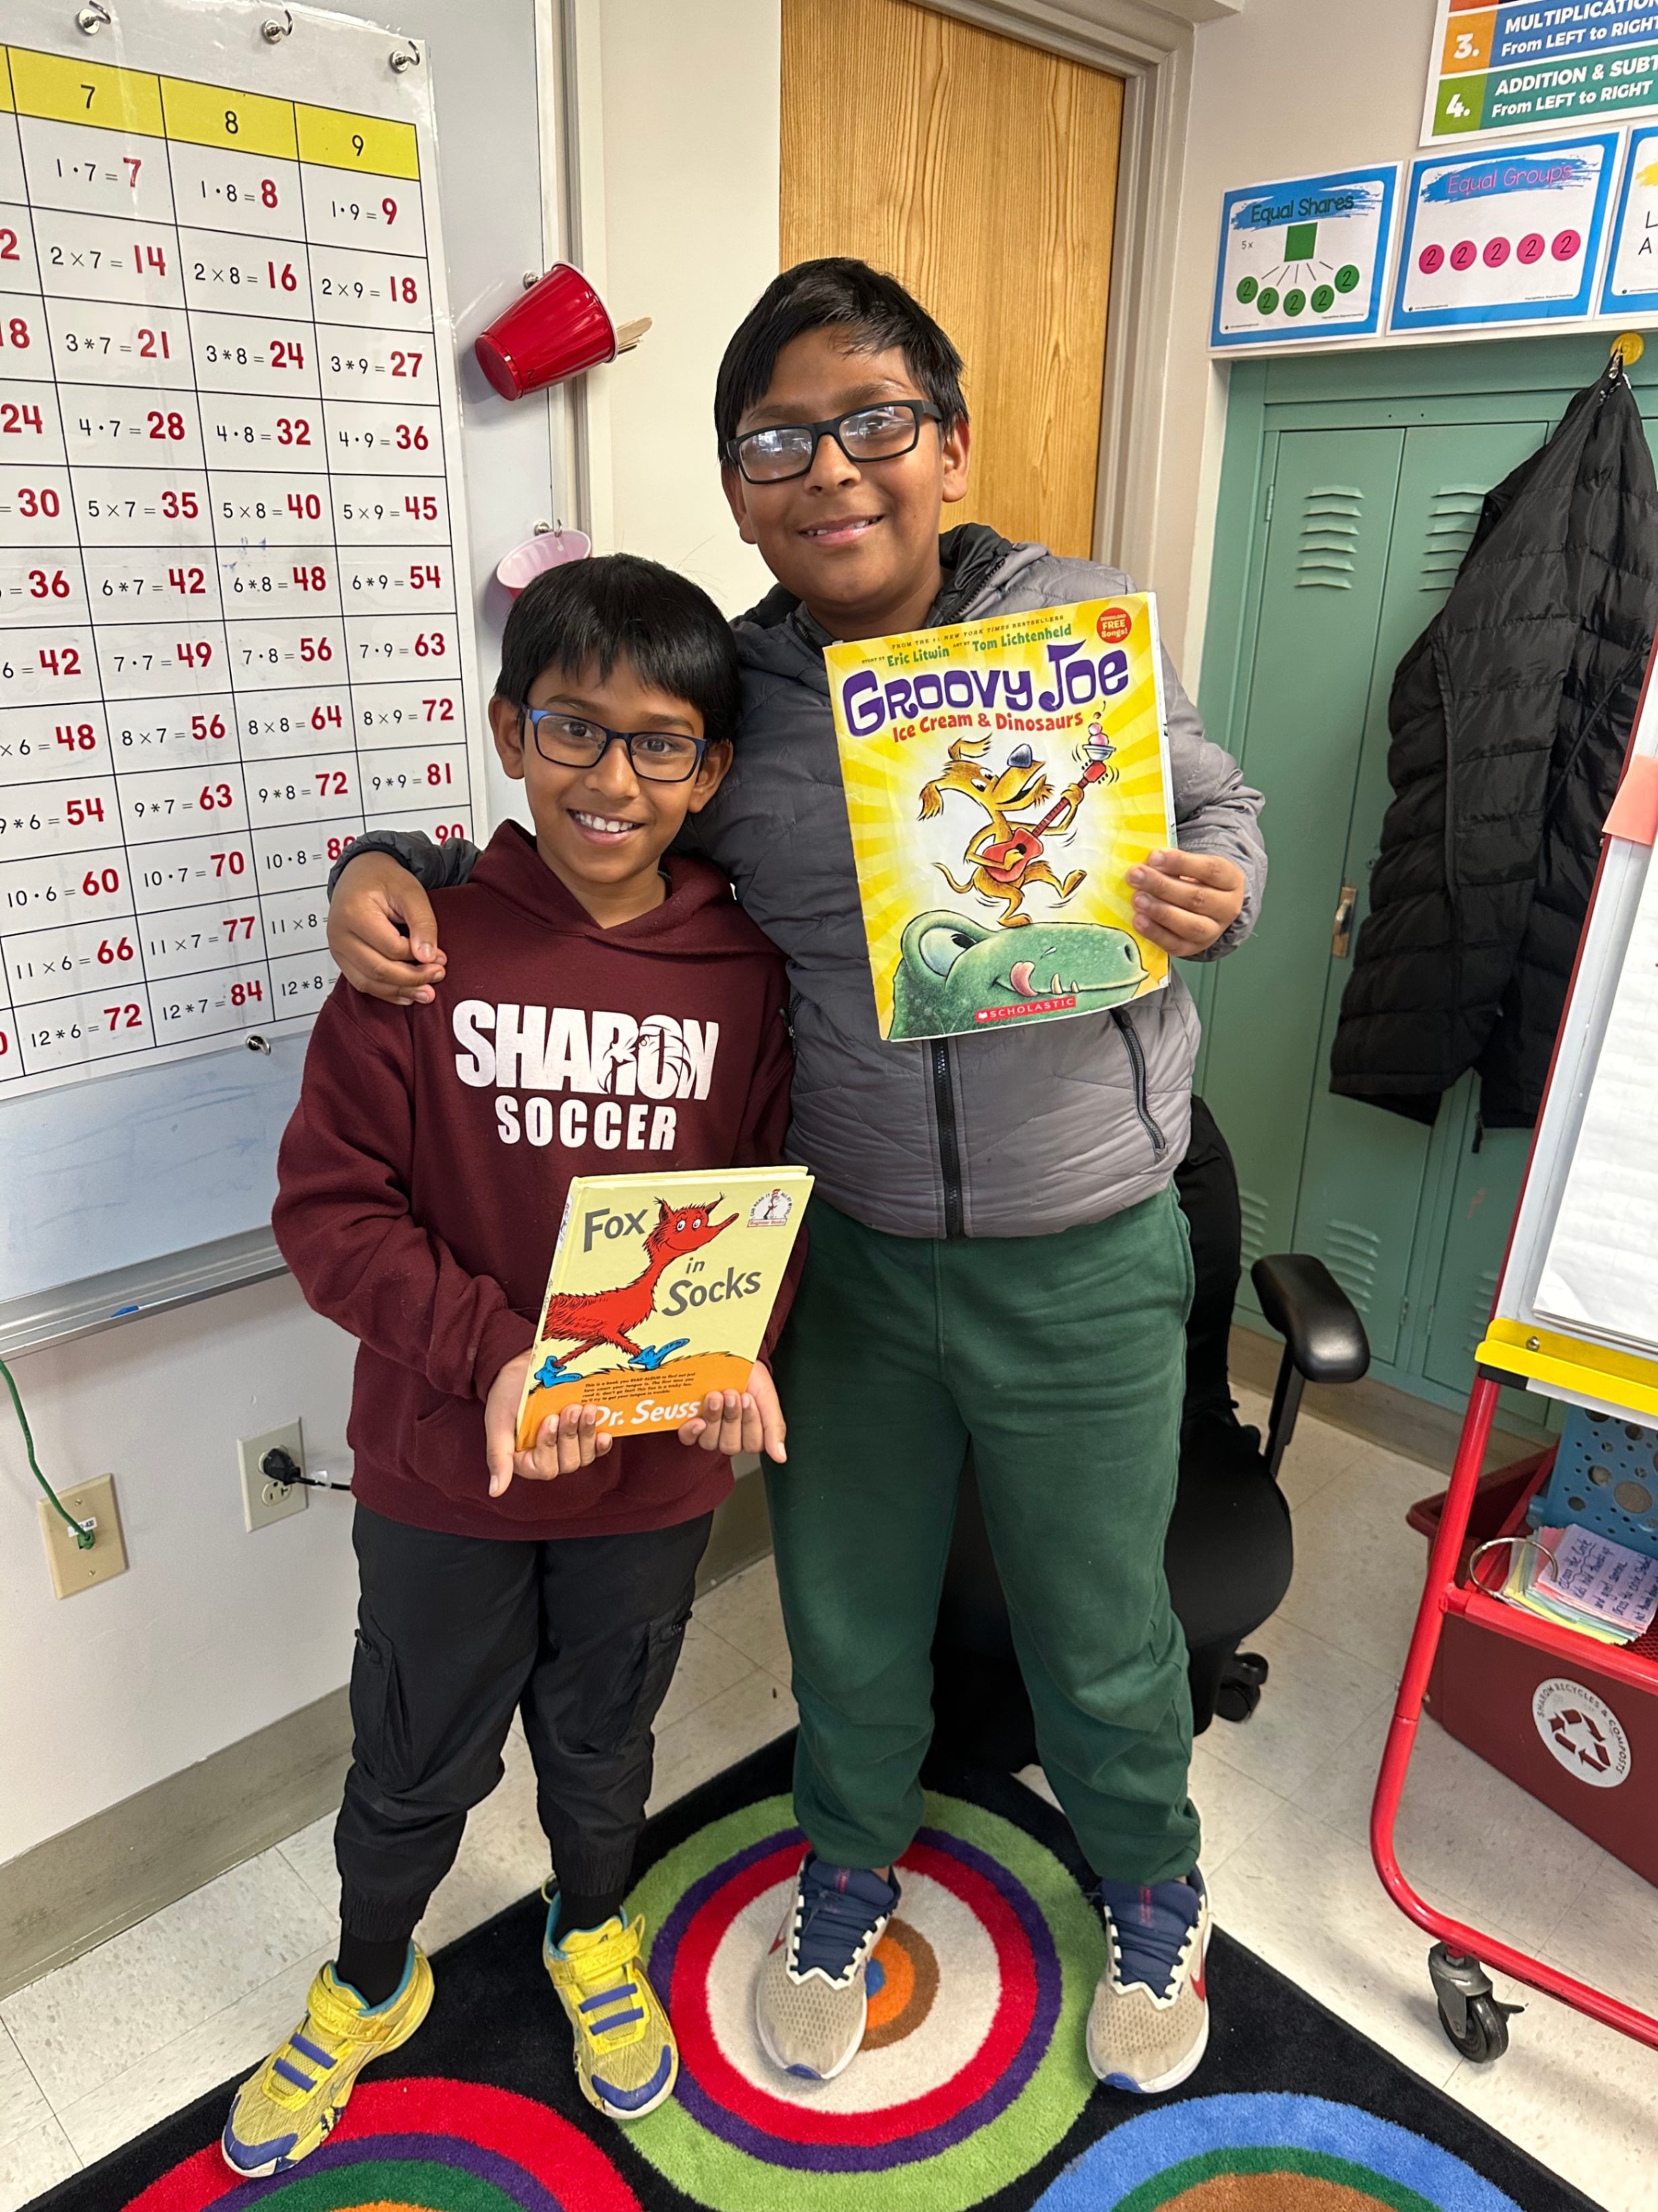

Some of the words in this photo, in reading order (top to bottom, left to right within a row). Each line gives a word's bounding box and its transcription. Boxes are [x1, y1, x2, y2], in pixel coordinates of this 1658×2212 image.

[1454, 34, 1479, 59] 3.
[1502, 38, 1541, 57] From
[1546, 29, 1587, 49] LEFT
[1590, 26, 1607, 40] to
[1495, 66, 1587, 96] ADDITION
[1592, 64, 1604, 80] &
[80, 84, 95, 109] 7
[1446, 94, 1471, 118] 4.
[1492, 102, 1531, 118] From
[1536, 92, 1576, 111] LEFT
[1579, 90, 1597, 104] to
[1600, 80, 1654, 102] RIGHT
[225, 110, 238, 134] 8
[352, 135, 364, 156] 9
[1448, 170, 1497, 197] Equal
[1503, 164, 1572, 187] Groups
[1250, 199, 1294, 226] Equal
[1298, 195, 1354, 216] Shares
[134, 245, 166, 276] 14
[1426, 249, 1436, 266] 2
[1457, 246, 1467, 264] 2
[1490, 243, 1502, 261] 2
[1525, 239, 1537, 257] 2
[1560, 236, 1572, 253] 2
[268, 261, 297, 292] 16
[390, 276, 418, 304] 18
[1242, 281, 1251, 296] 2
[1263, 292, 1271, 309] 2
[1289, 294, 1298, 310] 2
[1318, 290, 1327, 306] 2
[1342, 270, 1351, 286] 2
[137, 329, 170, 358] 21
[269, 340, 304, 369] 24
[391, 351, 422, 377] 27
[0, 404, 43, 434] 24
[147, 411, 185, 441] 28
[277, 418, 311, 445] 32
[395, 424, 428, 451] 36
[18, 488, 60, 517] 30
[162, 491, 199, 519] 35
[287, 494, 321, 519] 40
[405, 496, 437, 521] 45
[28, 570, 70, 598] 36
[168, 567, 205, 594] 42
[293, 566, 326, 592] 48
[410, 565, 441, 590] 54
[892, 641, 912, 650] FROM
[963, 629, 983, 637] YORK
[986, 625, 1009, 633] TIMES
[1012, 615, 1064, 628] BESTSELLERS
[1102, 619, 1126, 630] FREE
[1102, 627, 1128, 638] Songs!
[177, 641, 212, 668] 49
[300, 637, 332, 662] 56
[414, 633, 445, 657] 63
[887, 652, 910, 667] Eric
[914, 645, 949, 663] Litwin
[972, 639, 997, 652] Tom
[1001, 623, 1072, 647] Lichtenheld
[39, 648, 81, 676] 42
[311, 705, 342, 730] 64
[422, 698, 453, 722] 72
[55, 724, 96, 751] 48
[192, 714, 226, 740] 56
[893, 724, 916, 742] Ice
[920, 712, 972, 734] Cream
[978, 714, 990, 728] &
[996, 712, 1084, 732] Dinosaurs
[316, 771, 348, 796] 72
[427, 763, 451, 786] 81
[67, 797, 104, 825] 54
[199, 784, 232, 811] 63
[212, 851, 245, 877] 70
[82, 868, 119, 896] 60
[223, 916, 255, 944] 77
[97, 937, 133, 965] 66
[231, 981, 262, 1006] 84
[990, 998, 1074, 1017] SCHOLASTIC
[104, 1003, 141, 1031] 72
[452, 999, 720, 1101] SHARON
[495, 1095, 677, 1151] SOCCER
[583, 1207, 649, 1253] Fox
[686, 1256, 705, 1275] in
[661, 1267, 762, 1317] Socks
[630, 1399, 701, 1425] Seuss
[1537, 1685, 1556, 1717] SHARON
[1554, 1683, 1600, 1709] RECYCLES
[1608, 1719, 1627, 1774] COMPOSTS
